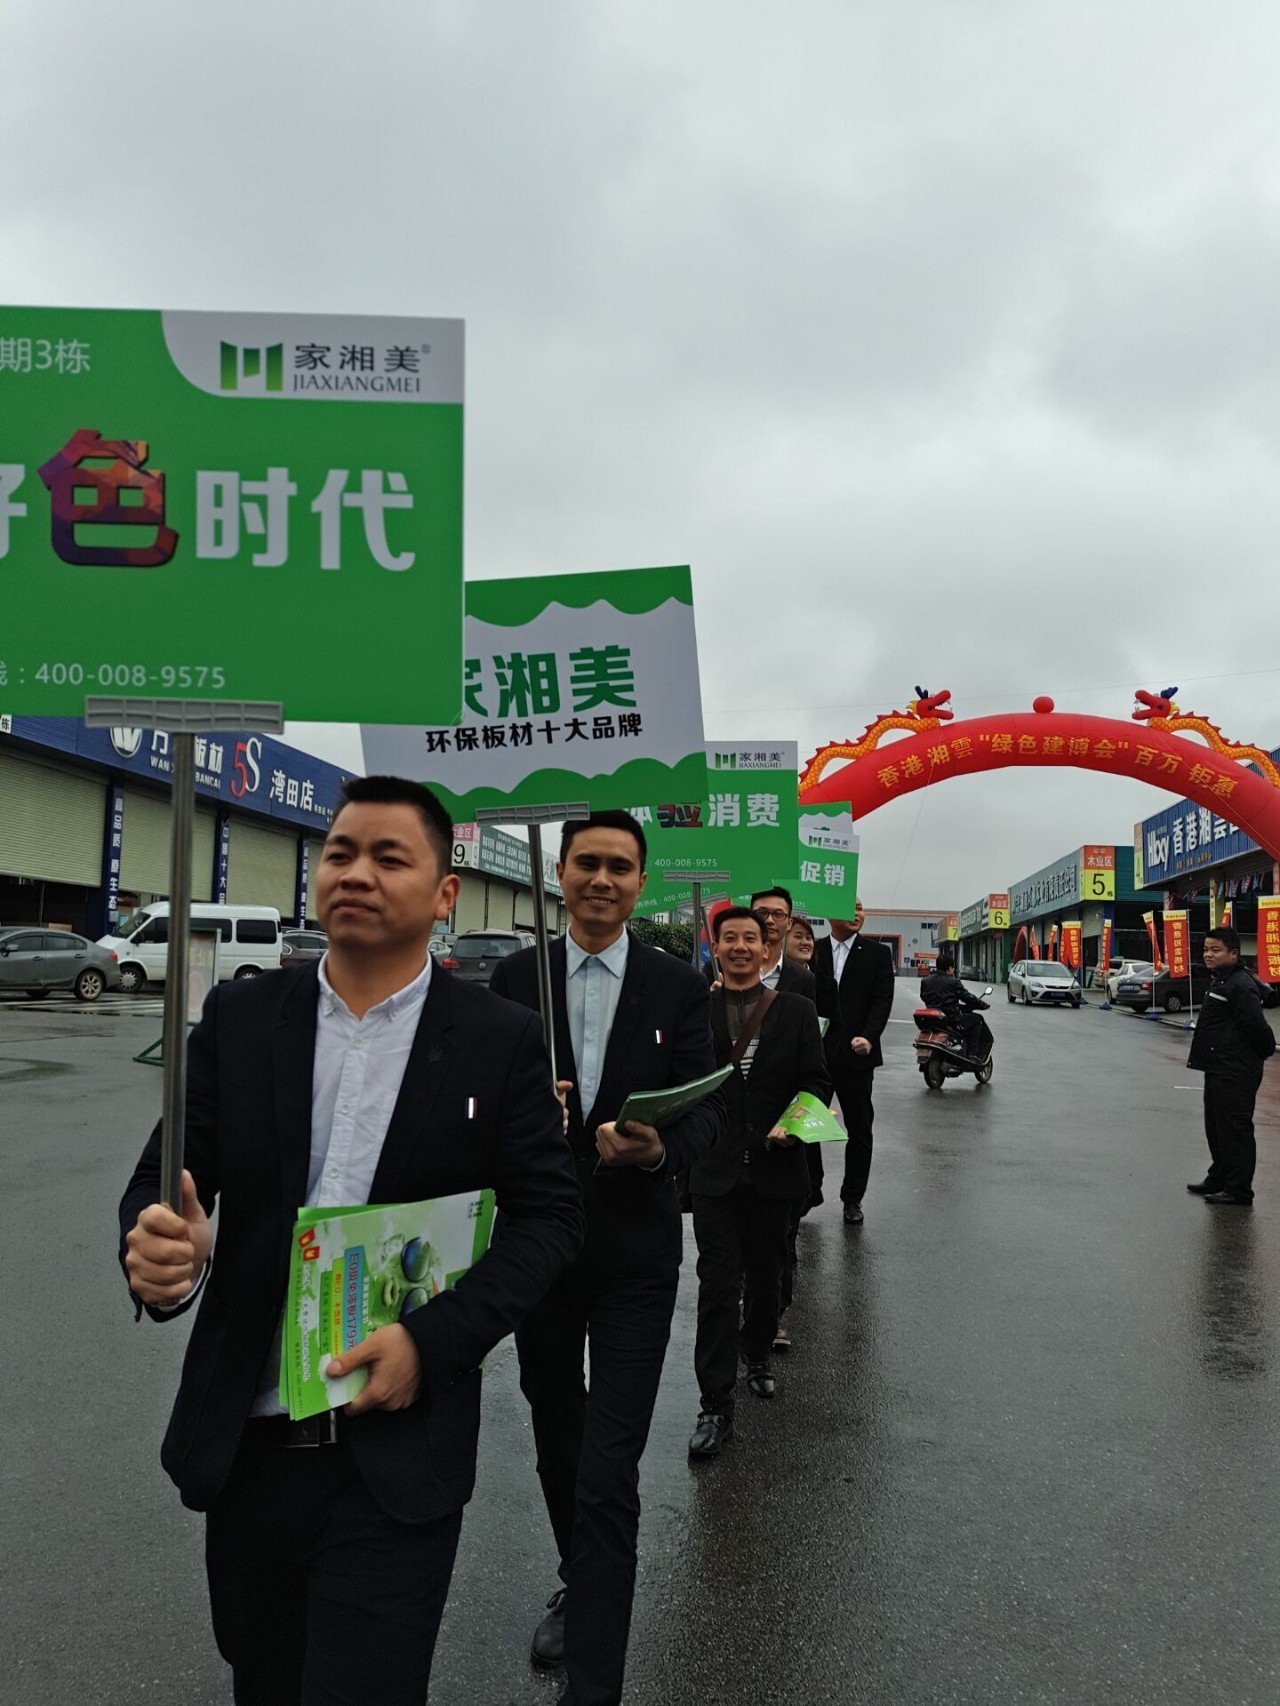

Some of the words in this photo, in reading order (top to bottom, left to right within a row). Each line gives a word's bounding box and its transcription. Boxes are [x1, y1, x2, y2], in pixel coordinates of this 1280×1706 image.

[294, 343, 421, 374] 家湘美
[293, 374, 421, 393] JIAXIANGMEI
[425, 712, 643, 753] 环保板材十大品牌
[739, 752, 782, 762] 家湘美
[195, 771, 221, 789] BANCAI
[270, 769, 315, 812] 湾田店
[453, 843, 466, 865] 9
[1087, 855, 1112, 867] 木业区
[800, 860, 845, 887] 促销
[1092, 873, 1106, 896] 5
[994, 911, 1003, 926] 6
